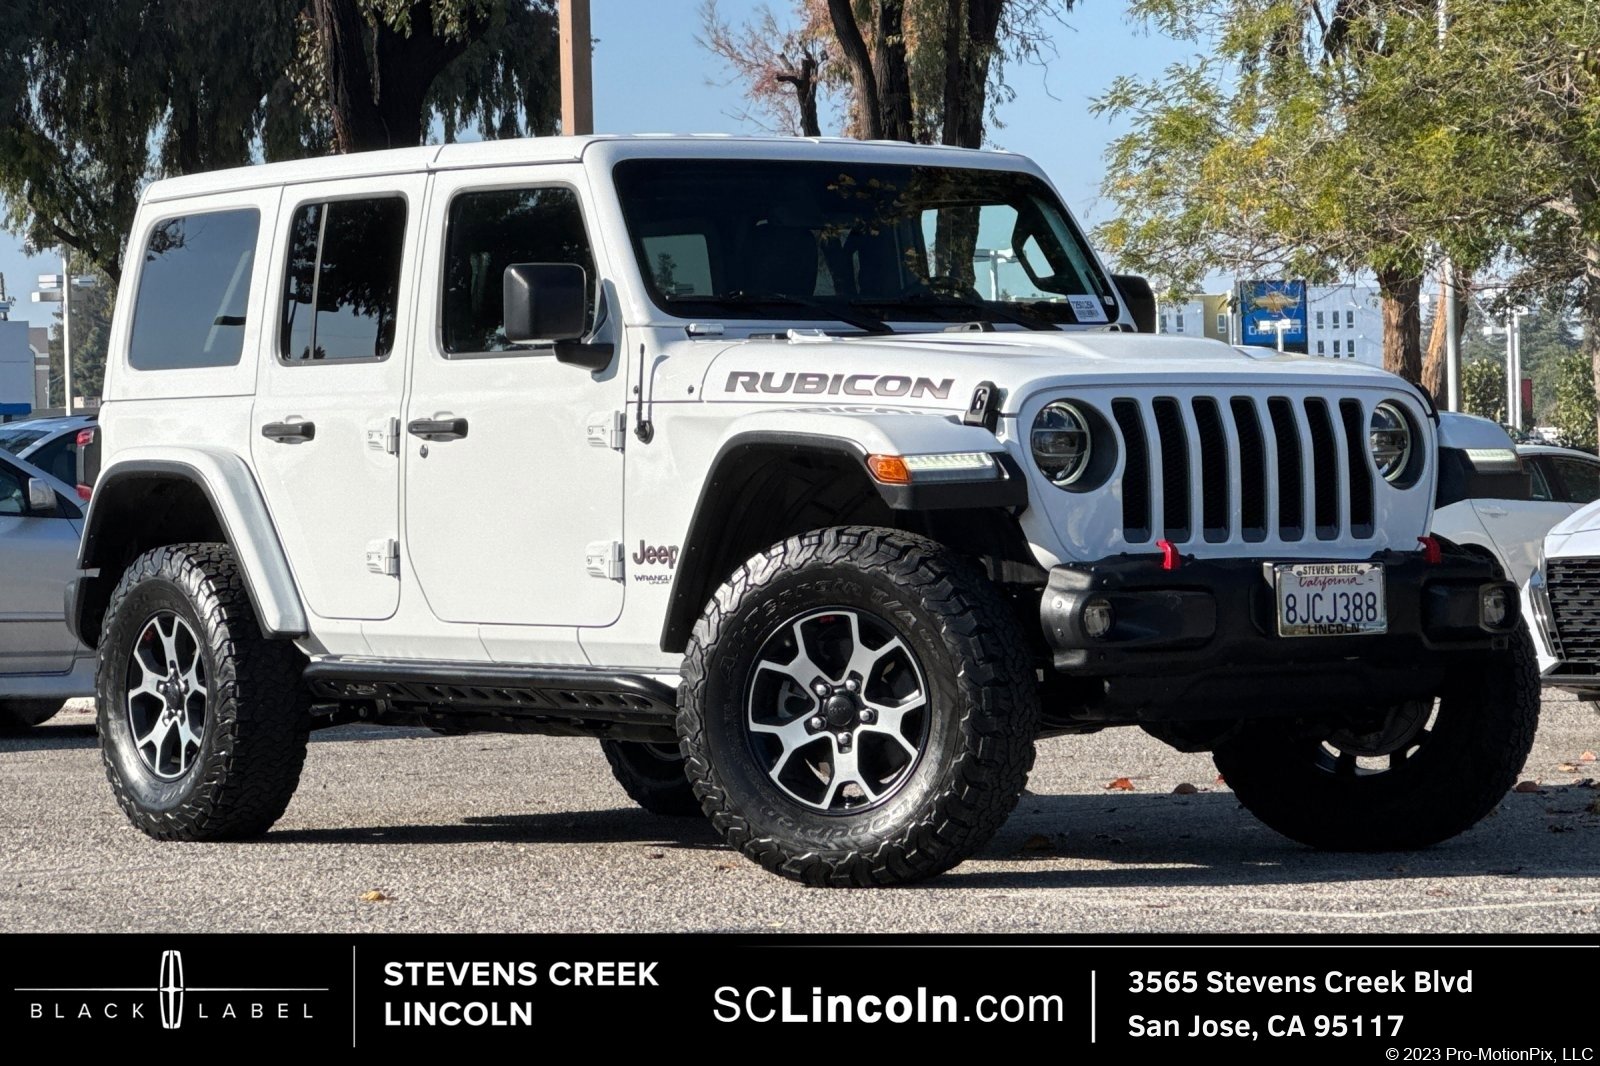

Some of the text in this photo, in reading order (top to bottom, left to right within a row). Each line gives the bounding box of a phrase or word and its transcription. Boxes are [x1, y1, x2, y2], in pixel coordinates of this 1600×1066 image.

[1248, 325, 1302, 336] CHEVLET
[724, 371, 955, 399] RUBICON
[632, 539, 679, 569] Jeep
[1302, 564, 1359, 575] STEVENS CREEK
[1299, 577, 1364, 591] California
[1285, 591, 1377, 624] 8JCJ388
[1307, 623, 1360, 634] LINCOLN
